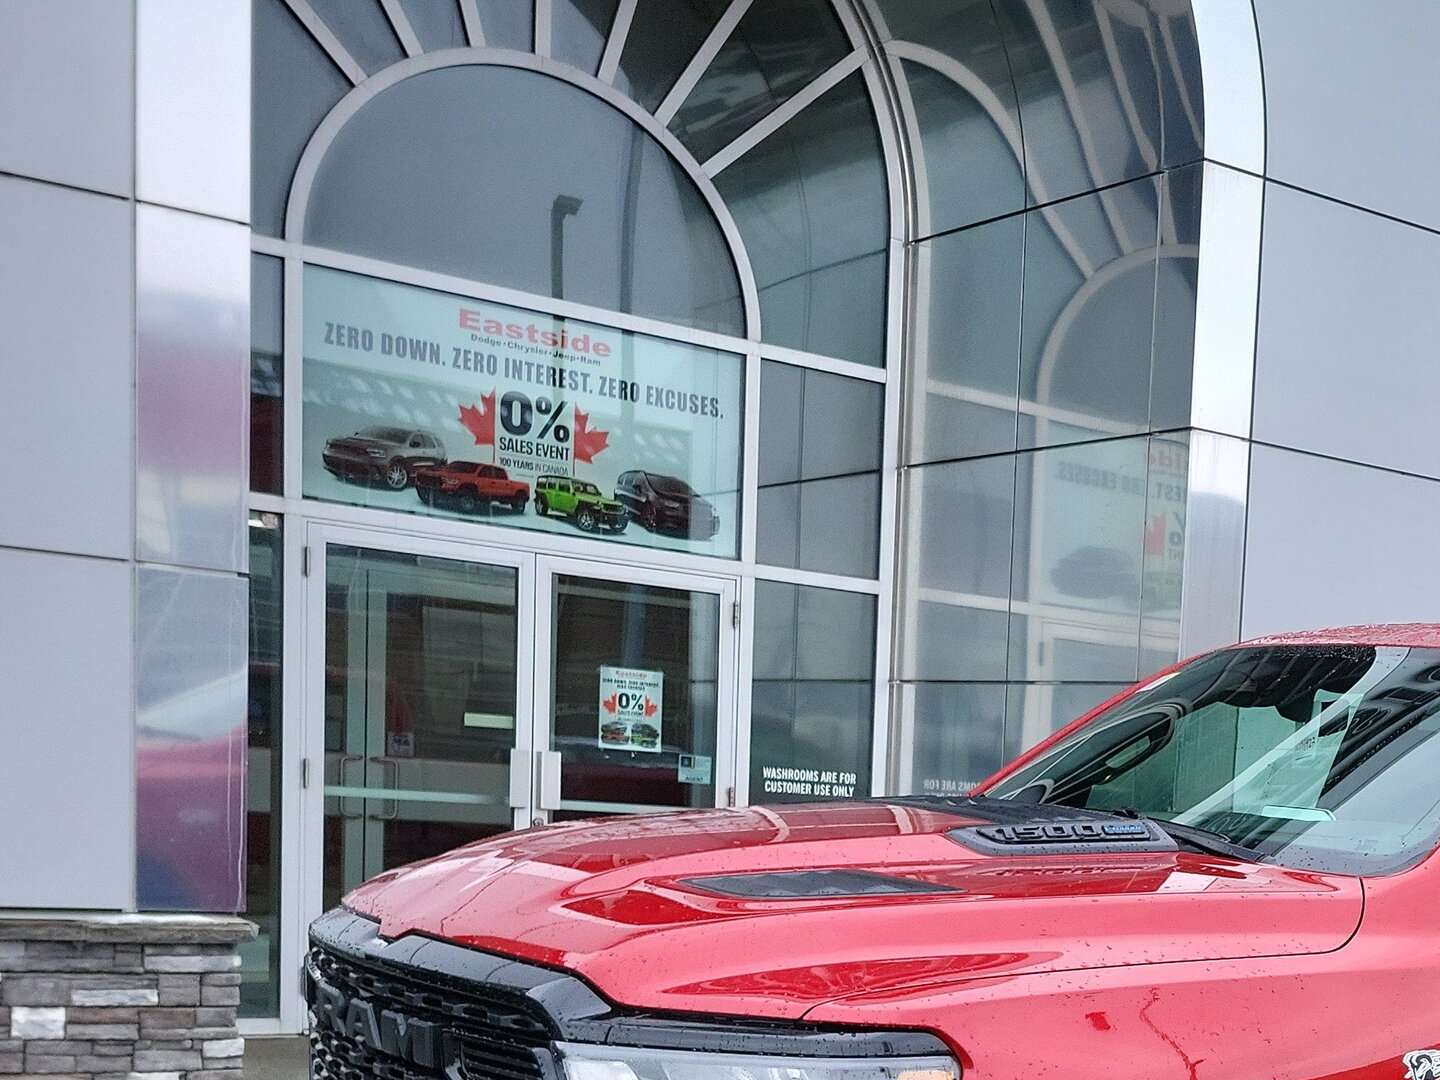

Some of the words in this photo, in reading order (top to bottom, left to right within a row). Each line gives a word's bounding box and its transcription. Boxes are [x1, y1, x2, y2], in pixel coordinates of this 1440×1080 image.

[458, 308, 613, 358] Eastside
[471, 333, 501, 348] Dodge
[507, 341, 549, 356] Chrysler
[553, 350, 577, 363] Jeep
[580, 355, 601, 367] Ram
[324, 321, 374, 353] ZERO
[381, 332, 447, 367] DOWN.
[452, 346, 498, 377] ZERO
[504, 357, 593, 394] INTEREST.
[599, 376, 640, 403] ZERO
[646, 384, 724, 419] EXCUSES.
[500, 391, 570, 443] 0%
[499, 437, 534, 456] SALES
[535, 443, 571, 462] EVENT
[513, 460, 534, 471] YEARS
[543, 464, 569, 476] CANADA
[618, 692, 644, 711] 0%
[763, 766, 819, 783] WASHROOMS
[820, 771, 838, 784] ARE
[840, 773, 857, 785] FOR
[764, 780, 812, 795] CUSTOMER
[813, 784, 831, 796] USE
[832, 785, 855, 798] ONLY
[996, 824, 1101, 840] 1500
[314, 978, 437, 1069] RAM
